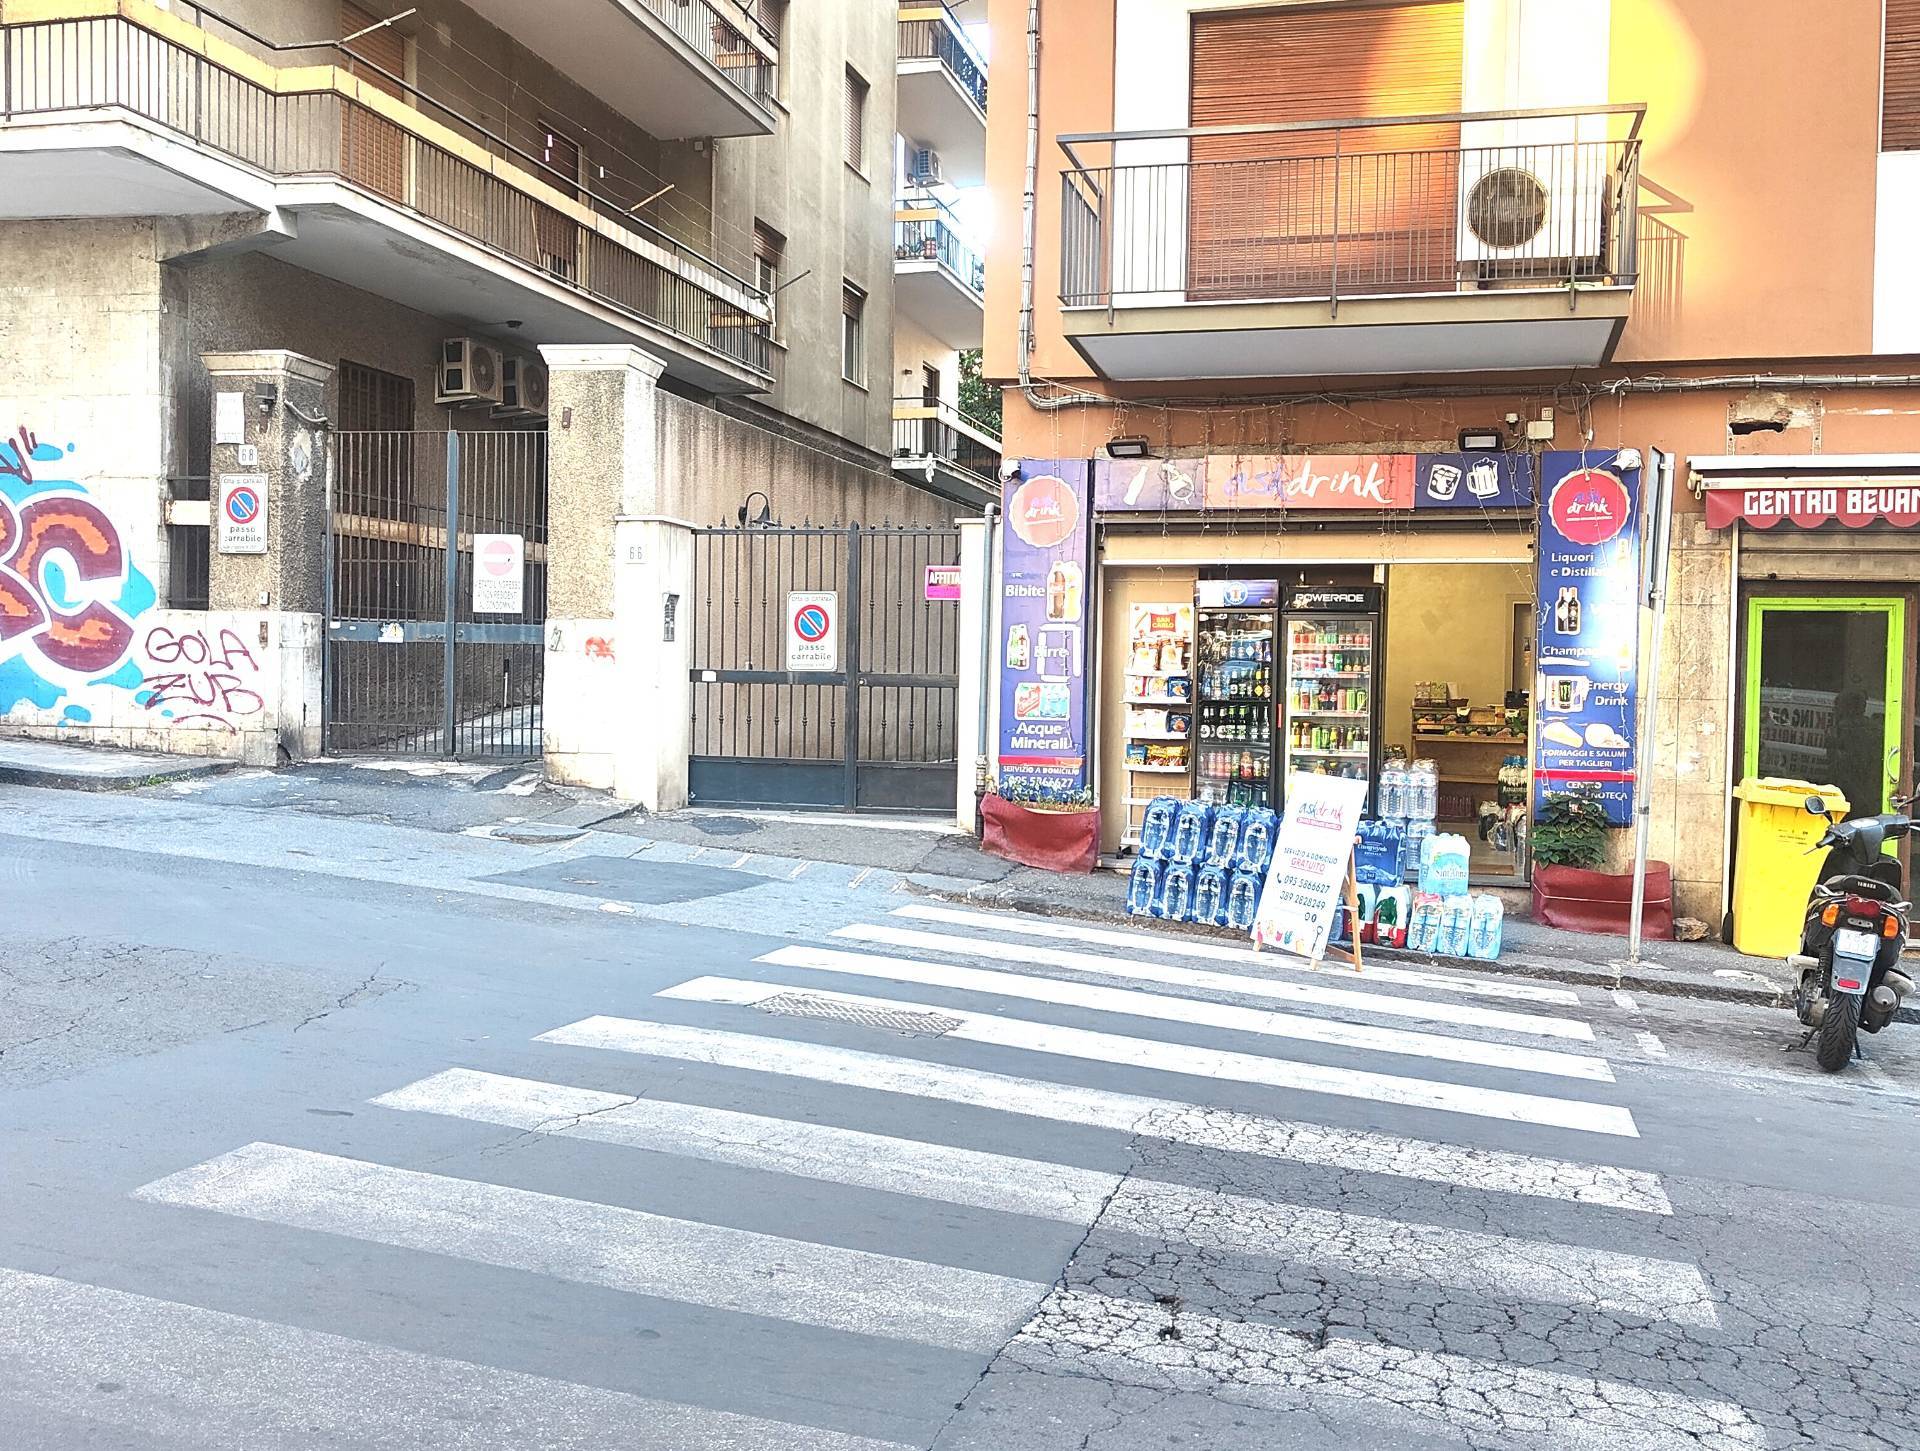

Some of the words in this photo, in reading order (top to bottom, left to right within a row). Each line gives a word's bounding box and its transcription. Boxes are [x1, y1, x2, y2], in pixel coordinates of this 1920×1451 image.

[1566, 496, 1613, 515] drink
[1743, 490, 1837, 515] CENTRO
[229, 526, 257, 535] passo
[629, 546, 643, 560] 66
[1551, 552, 1595, 566] Liquori
[1551, 568, 1559, 577] e
[1005, 584, 1046, 598] Bibite
[1295, 592, 1365, 604] POWERADE
[145, 626, 259, 671] GOLA
[798, 644, 825, 652] passo
[791, 652, 832, 661] carrabile
[1588, 680, 1630, 694] Energy
[1594, 695, 1629, 706] Drink
[1016, 721, 1064, 738] Acque
[1010, 737, 1068, 750] Minerali
[1543, 749, 1588, 758] FORMAGGI
[1589, 750, 1595, 758] E
[1596, 750, 1628, 759] SALUMI
[1003, 764, 1034, 774] SERVIZIO
[1035, 766, 1041, 774] A
[1042, 767, 1080, 776] DOMICILIO
[1558, 759, 1575, 767] PER
[1576, 759, 1613, 768] TAGLIERI
[1585, 791, 1628, 799] NOTECA
[1291, 857, 1326, 873] GRATUITO
[1283, 875, 1297, 886] 095
[1298, 878, 1331, 894] 5866627
[1857, 880, 1876, 889] YAMAHA
[1279, 890, 1294, 901] 389
[1294, 894, 1326, 911] 2828249
